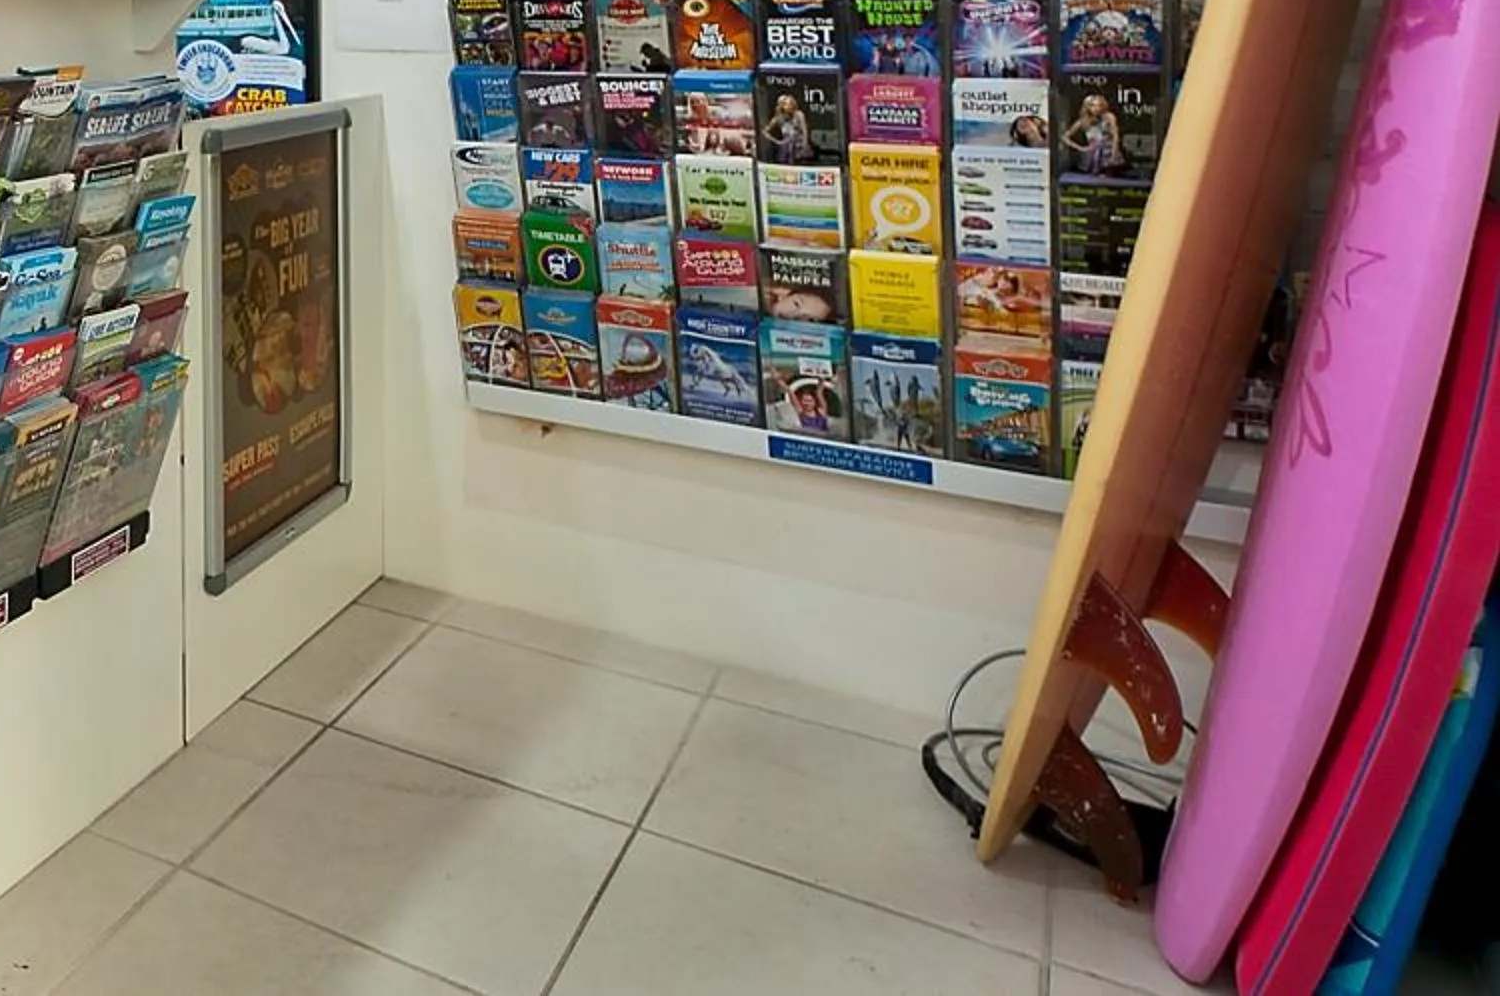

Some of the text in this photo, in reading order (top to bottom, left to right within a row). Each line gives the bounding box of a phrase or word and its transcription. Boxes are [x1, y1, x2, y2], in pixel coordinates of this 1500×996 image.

[766, 23, 835, 45] BEST
[769, 43, 836, 60] WORLD
[766, 73, 797, 89] shop
[1070, 72, 1108, 89] shop
[236, 86, 288, 103] CRAB
[803, 84, 825, 104] in
[961, 89, 1009, 104] outlet
[1117, 83, 1142, 104] in
[961, 100, 1041, 117] shopping
[860, 156, 929, 169] CAR HIRE
[531, 228, 585, 243] TIMETABLE
[771, 256, 829, 269] MASSAGE
[279, 253, 310, 297] FUN
[773, 274, 831, 286] PAMPER
